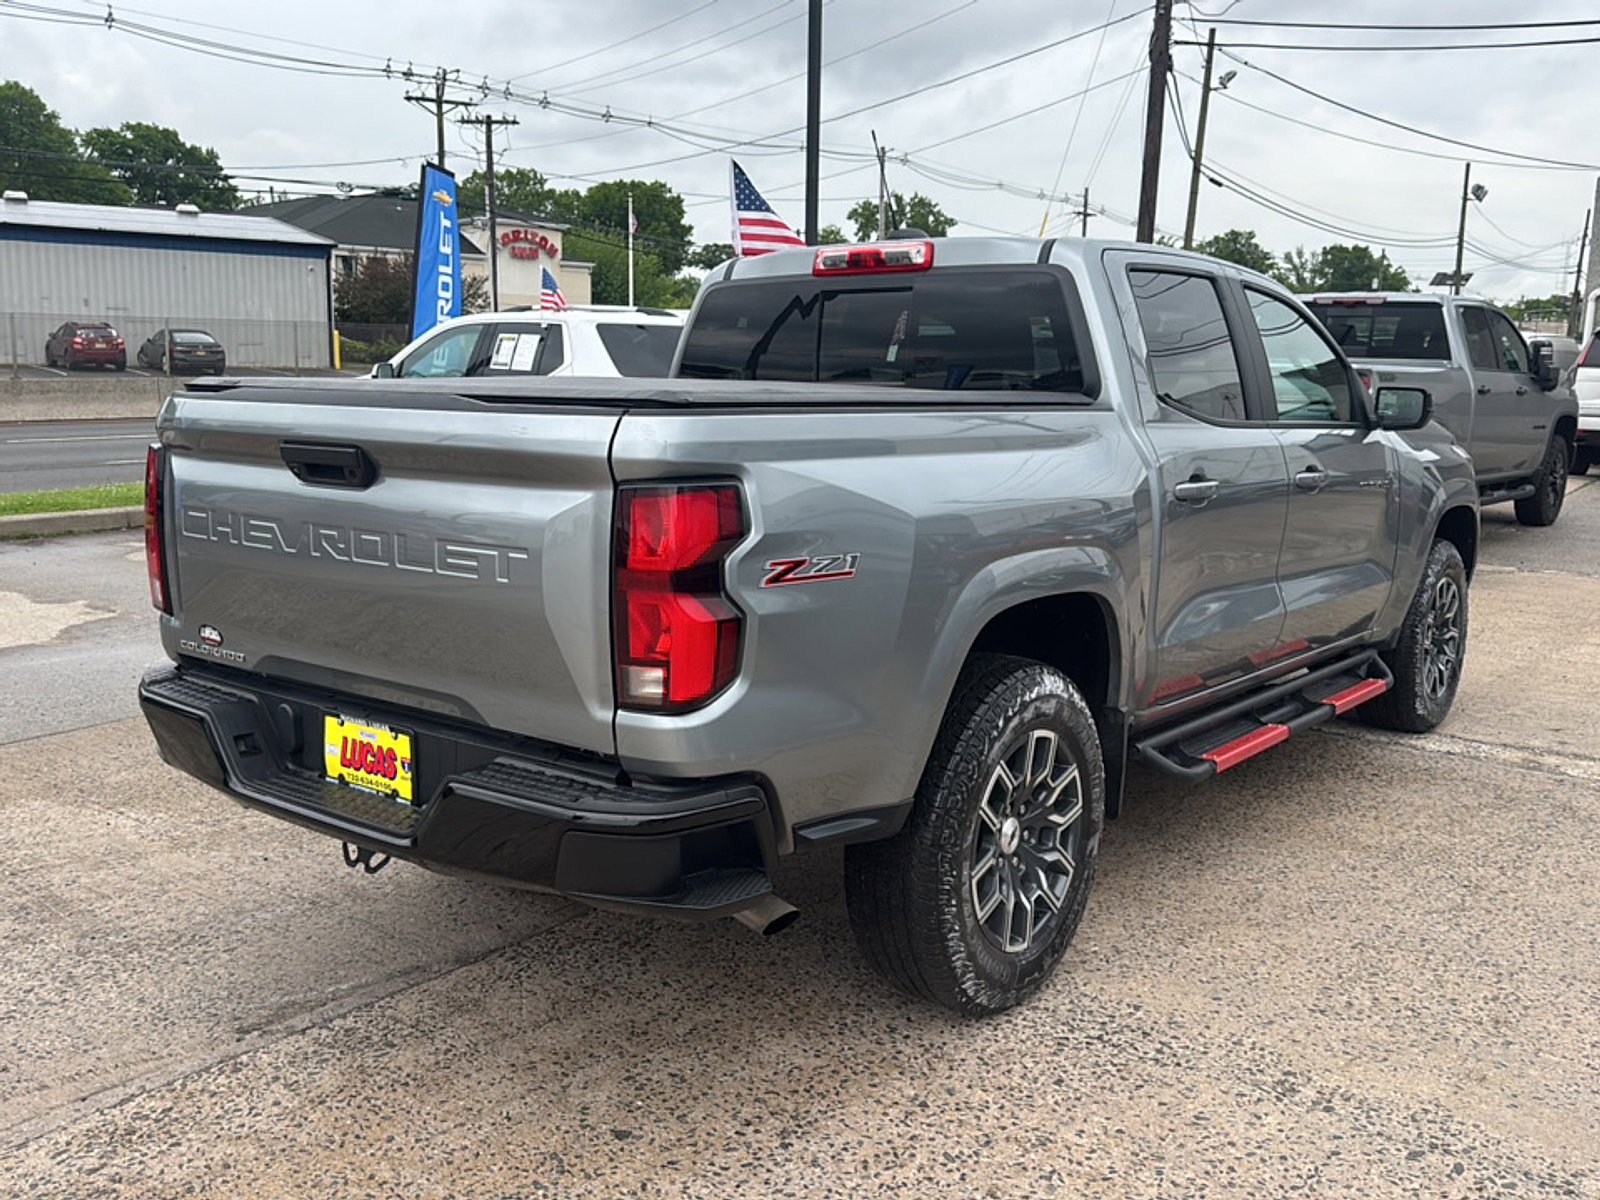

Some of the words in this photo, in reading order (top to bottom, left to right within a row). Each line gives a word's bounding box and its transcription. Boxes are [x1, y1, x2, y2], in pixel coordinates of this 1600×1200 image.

[181, 508, 529, 583] CHEVROLET
[759, 553, 861, 587] Z71
[341, 735, 398, 781] LUCAS
